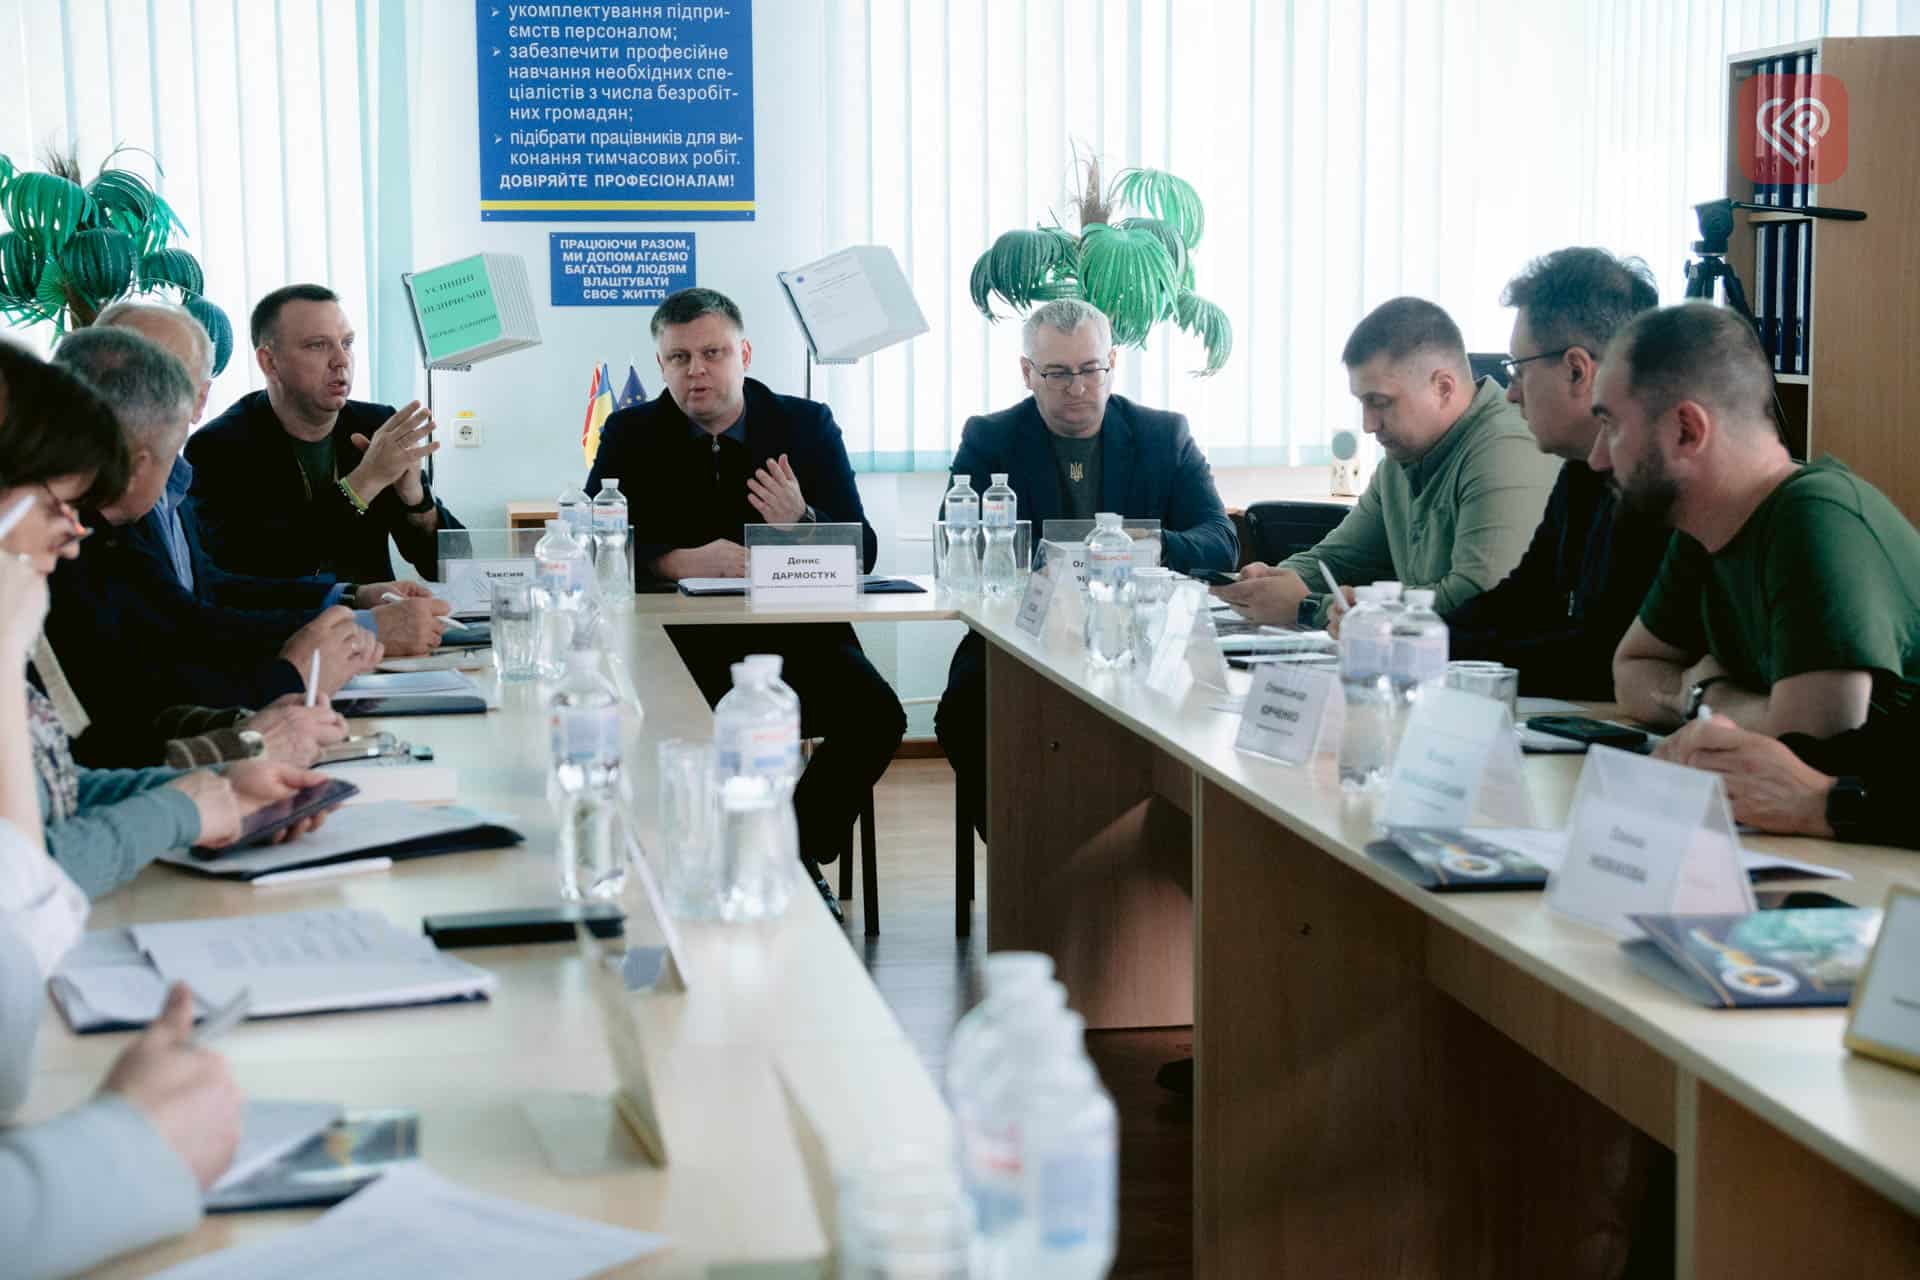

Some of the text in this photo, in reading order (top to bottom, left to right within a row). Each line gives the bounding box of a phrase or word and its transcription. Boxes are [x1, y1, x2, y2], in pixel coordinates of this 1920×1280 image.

[508, 3, 731, 22] укомплектування підпри-
[508, 26, 677, 41] ємств персоналом;
[509, 42, 729, 62] забезпечити професійне
[508, 64, 734, 82] навчання необхідних спе-
[508, 83, 740, 104] ціалістів з числа безробіт-
[509, 107, 633, 123] них громадян;
[510, 129, 744, 148] підібрати працівників для ви-
[510, 149, 741, 168] конання тимчасових робіт.
[499, 172, 735, 190] ДОВІРЯЙТЕ ПРОФЕСІОНАЛАМ!
[560, 239, 691, 251] ПРАЦЮЮЧИ РАЗОМ,
[562, 251, 689, 263] МИ ДОПОМАГАЄМО
[564, 264, 687, 275] БАГАТЬОМ ЛЮДЯМ
[583, 276, 669, 288] ВЛАШТУВАТИ
[583, 289, 618, 299] СВОЄ
[787, 556, 821, 566] Денис
[772, 571, 837, 581] ДАРМОСТУК
